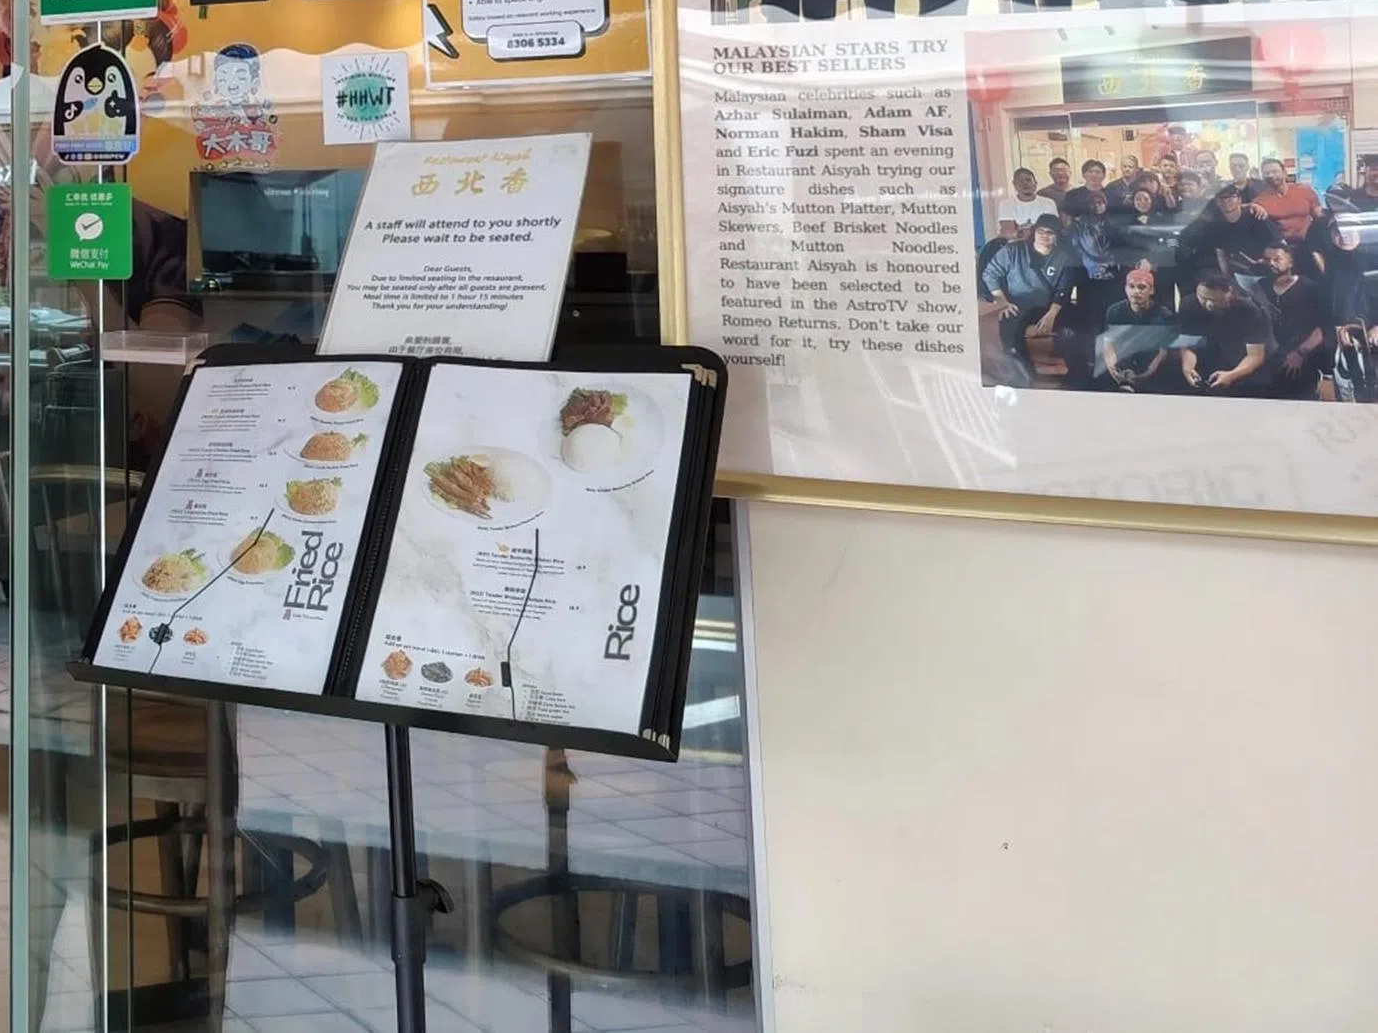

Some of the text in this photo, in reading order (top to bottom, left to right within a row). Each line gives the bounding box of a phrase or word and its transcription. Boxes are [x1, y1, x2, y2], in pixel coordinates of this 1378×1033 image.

[538, 37, 565, 46] 5334
[713, 39, 949, 60] MALAYSIAN STARS TRY
[713, 57, 906, 75] OUR BEST SELLERS
[336, 86, 395, 108] #HHWT
[714, 87, 952, 104] Malaysian celebrities such as
[714, 109, 761, 121] Azhar
[772, 107, 852, 121] Sulaiman,
[864, 106, 912, 118] Adam
[715, 125, 954, 139] Norman Hakim, Sham Visa
[203, 130, 273, 159] 大木哥
[716, 145, 954, 160] and Eric Fuzi spent an evening
[717, 164, 956, 178] in Restaurant Aisyah trying our
[411, 167, 528, 196] 西北香
[718, 202, 957, 216] Aisyah's Mutton Platter, Mutton
[365, 216, 562, 230] A staff will attend to you shortly
[718, 221, 958, 234] Skewers, Beef Brisket Noodles
[382, 232, 533, 244] Please wait to be seated.
[70, 248, 109, 260] 微信支付
[719, 240, 959, 254] and Mutton Noodles.
[70, 261, 108, 270] WeChat Pay
[444, 265, 472, 273] Guests,
[720, 258, 960, 275] Restaurant Aisyah is honoured
[721, 295, 962, 314] featured in the AstroTV show,
[283, 530, 323, 609] Fried
[305, 542, 344, 611] Rice
[603, 583, 641, 661] Rice
